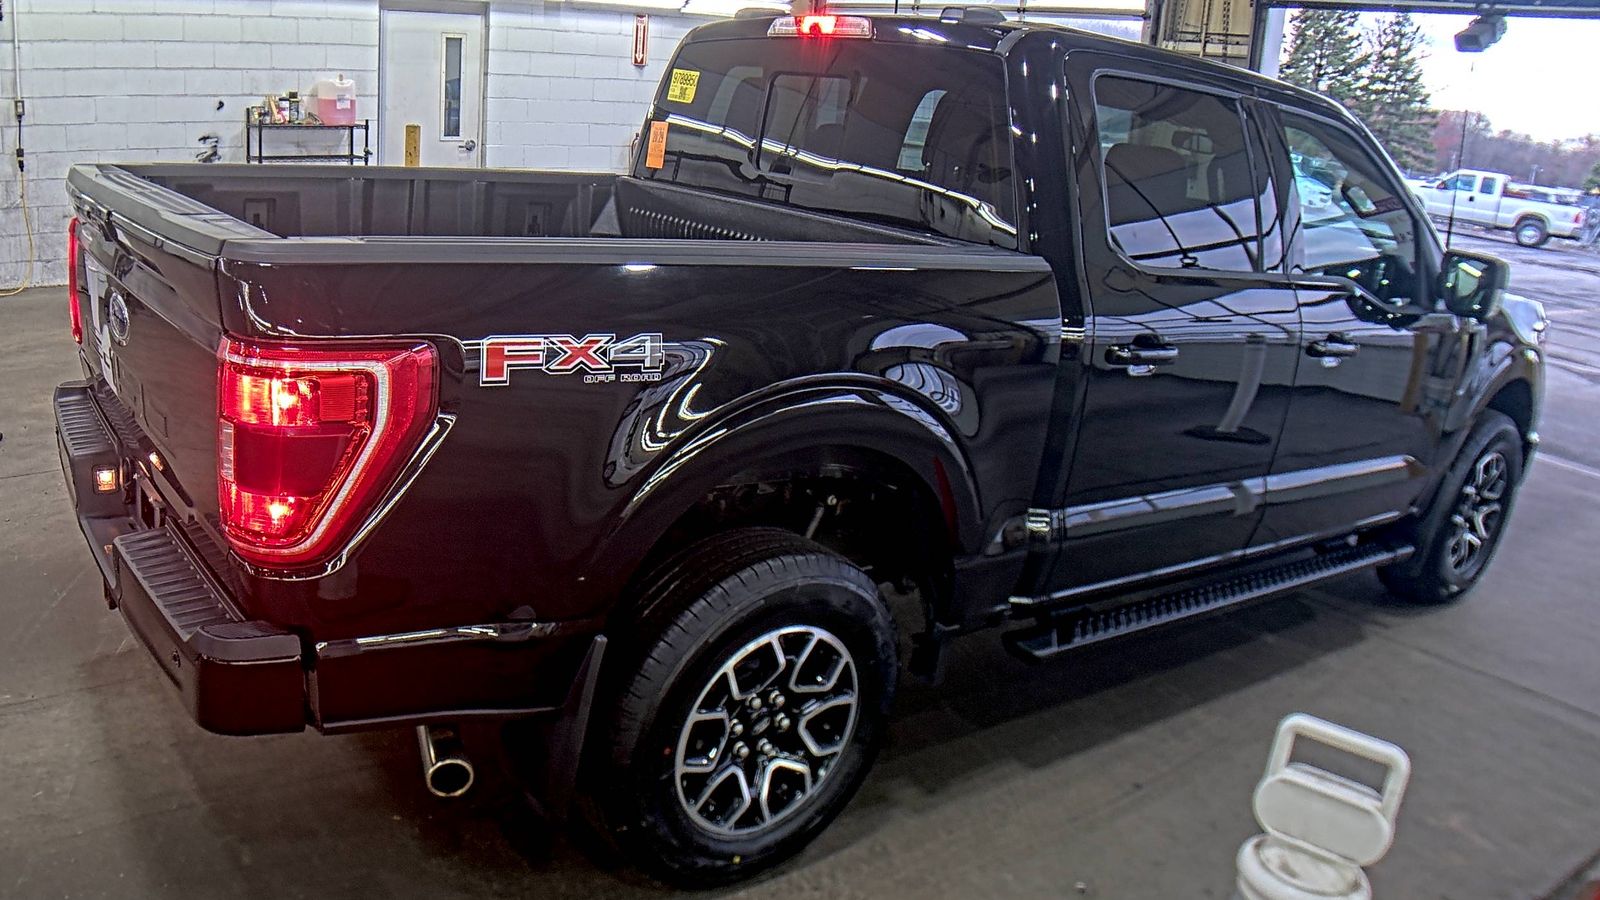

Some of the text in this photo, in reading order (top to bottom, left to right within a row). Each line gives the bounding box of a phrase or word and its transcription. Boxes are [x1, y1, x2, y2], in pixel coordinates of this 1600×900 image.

[480, 333, 664, 386] FX4
[584, 373, 661, 383] OFF ROAD
